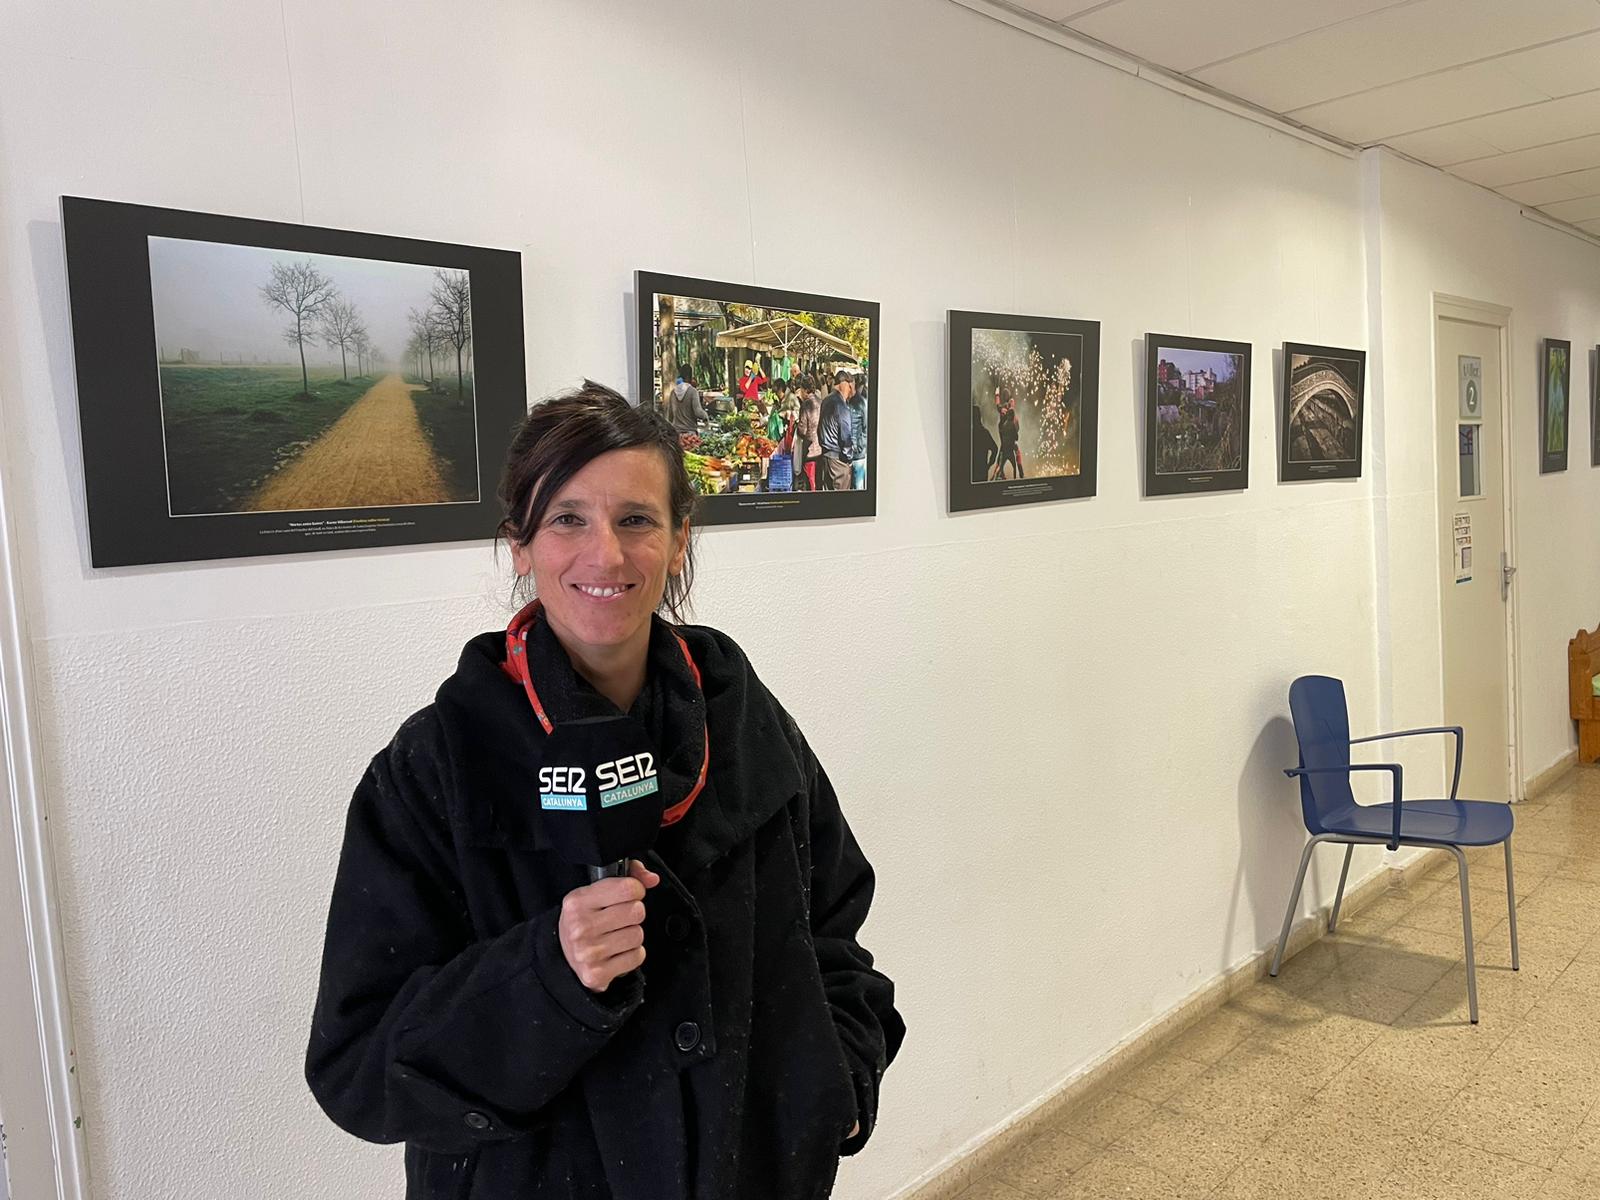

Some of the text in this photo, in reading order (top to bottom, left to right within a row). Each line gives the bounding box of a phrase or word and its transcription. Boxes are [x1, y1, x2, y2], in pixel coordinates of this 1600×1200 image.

[1469, 386, 1475, 405] 2
[538, 767, 587, 793] SER
[595, 752, 658, 791] SER
[543, 797, 584, 808] CATALUNYA
[603, 781, 655, 804] CATALUNYA
